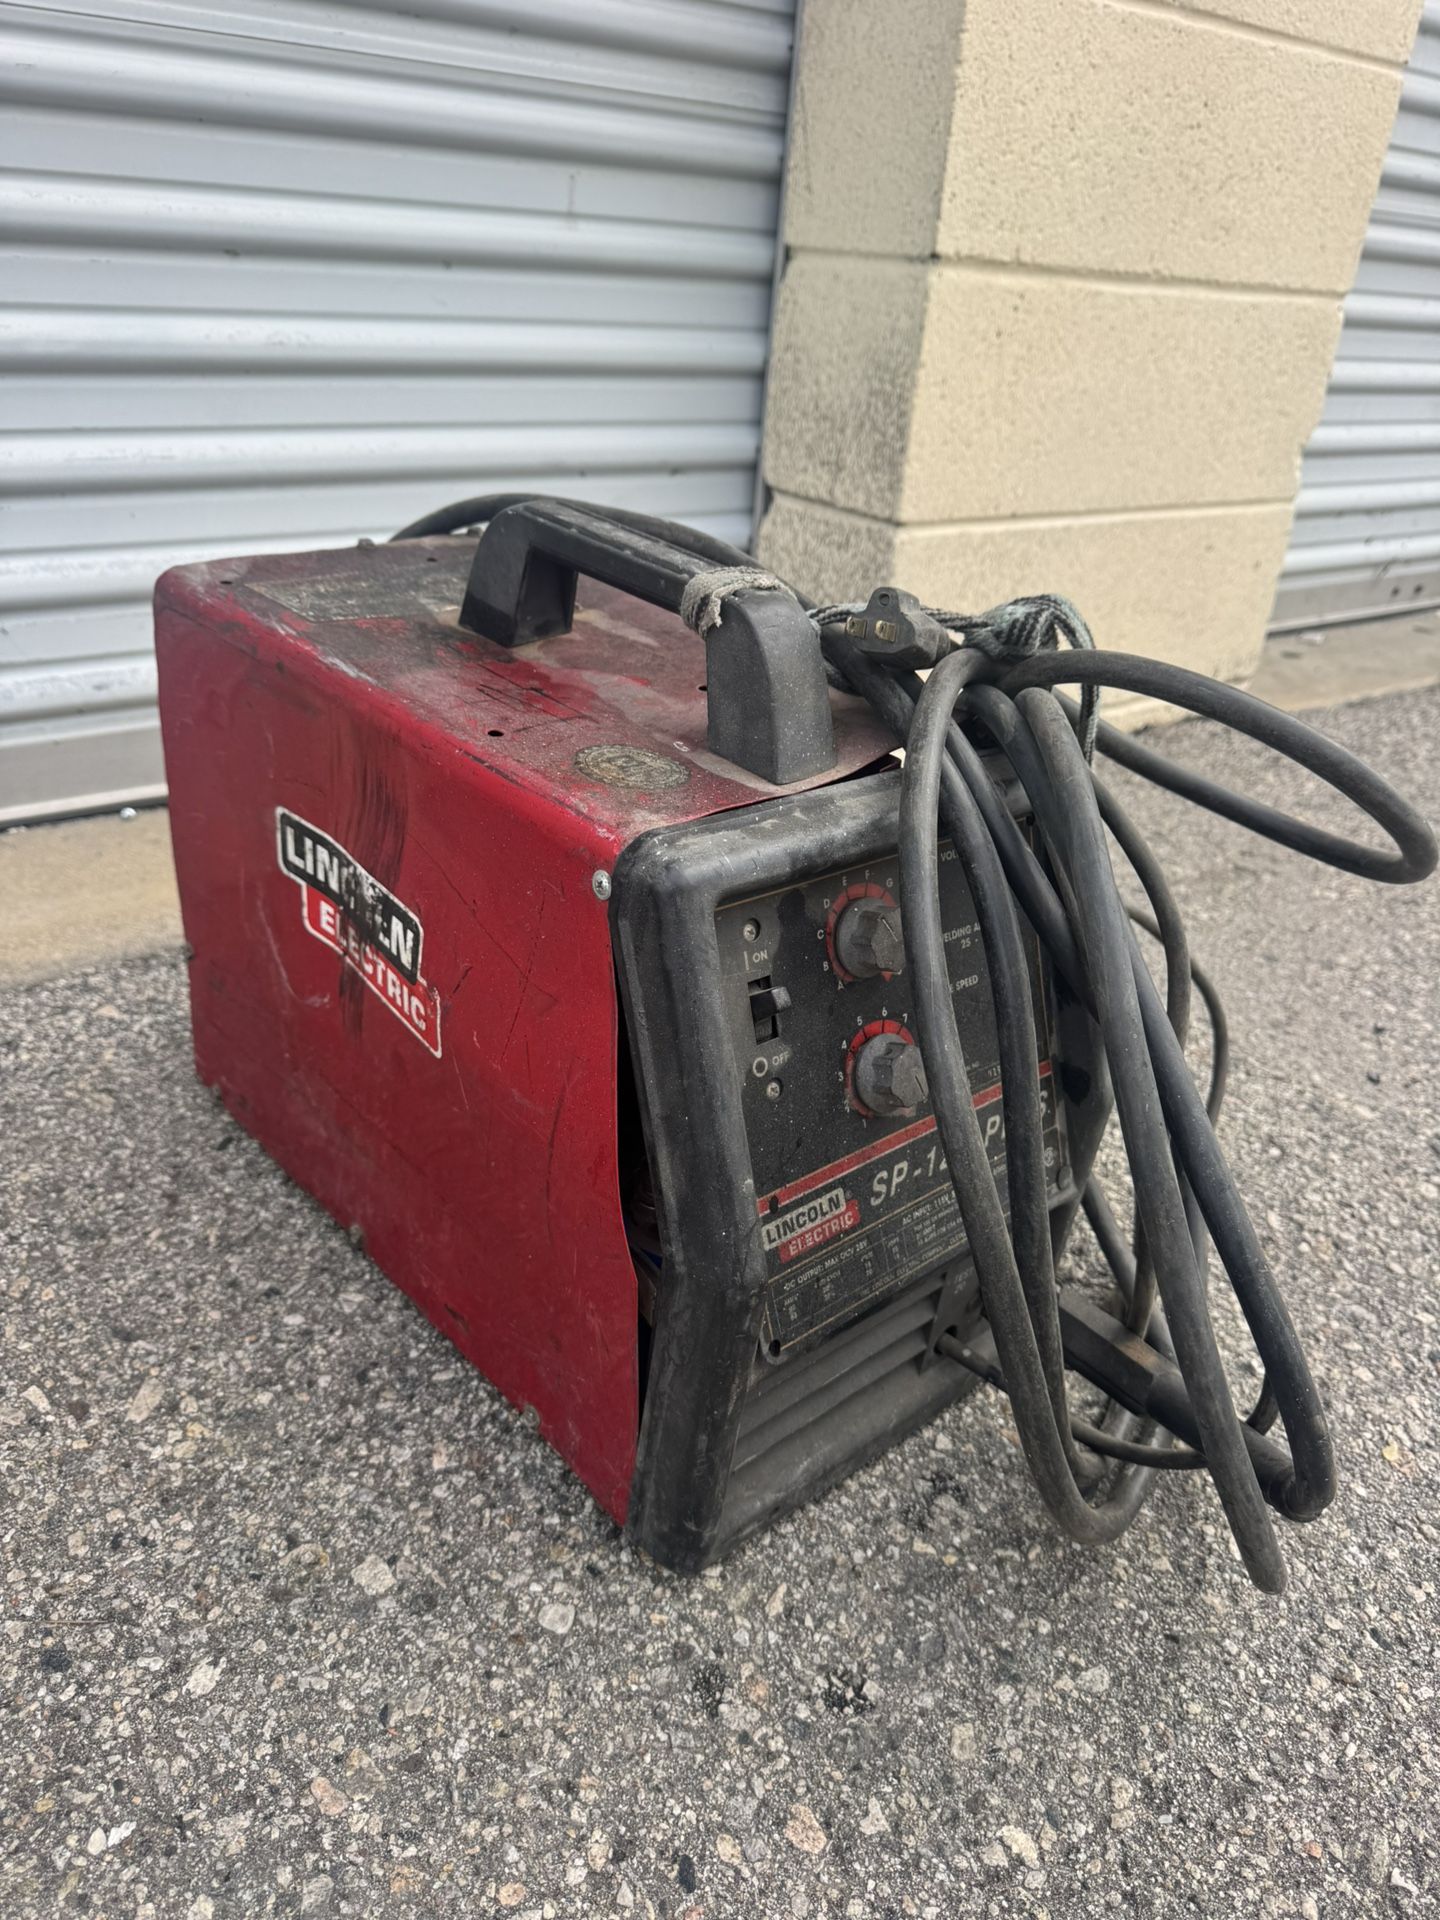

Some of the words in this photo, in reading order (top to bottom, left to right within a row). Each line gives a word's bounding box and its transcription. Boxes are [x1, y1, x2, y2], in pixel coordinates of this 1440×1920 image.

[941, 849, 960, 861] VOL
[841, 875, 848, 887] E
[885, 877, 894, 889] G
[286, 824, 415, 972] LINLN
[823, 898, 830, 909] D
[816, 929, 824, 940] C
[942, 924, 972, 943] ELDING
[961, 937, 971, 949] 25
[753, 949, 769, 963] ON
[823, 960, 830, 972] B
[837, 979, 845, 990] A
[955, 974, 979, 991] SPEED
[881, 1006, 888, 1017] 6
[856, 1015, 863, 1026] 5
[902, 1013, 909, 1024] 7
[841, 1039, 848, 1050] 4
[772, 1050, 790, 1066] OFF
[765, 1192, 846, 1246] LINCOLN
[789, 1212, 855, 1256] ELECTRIC
